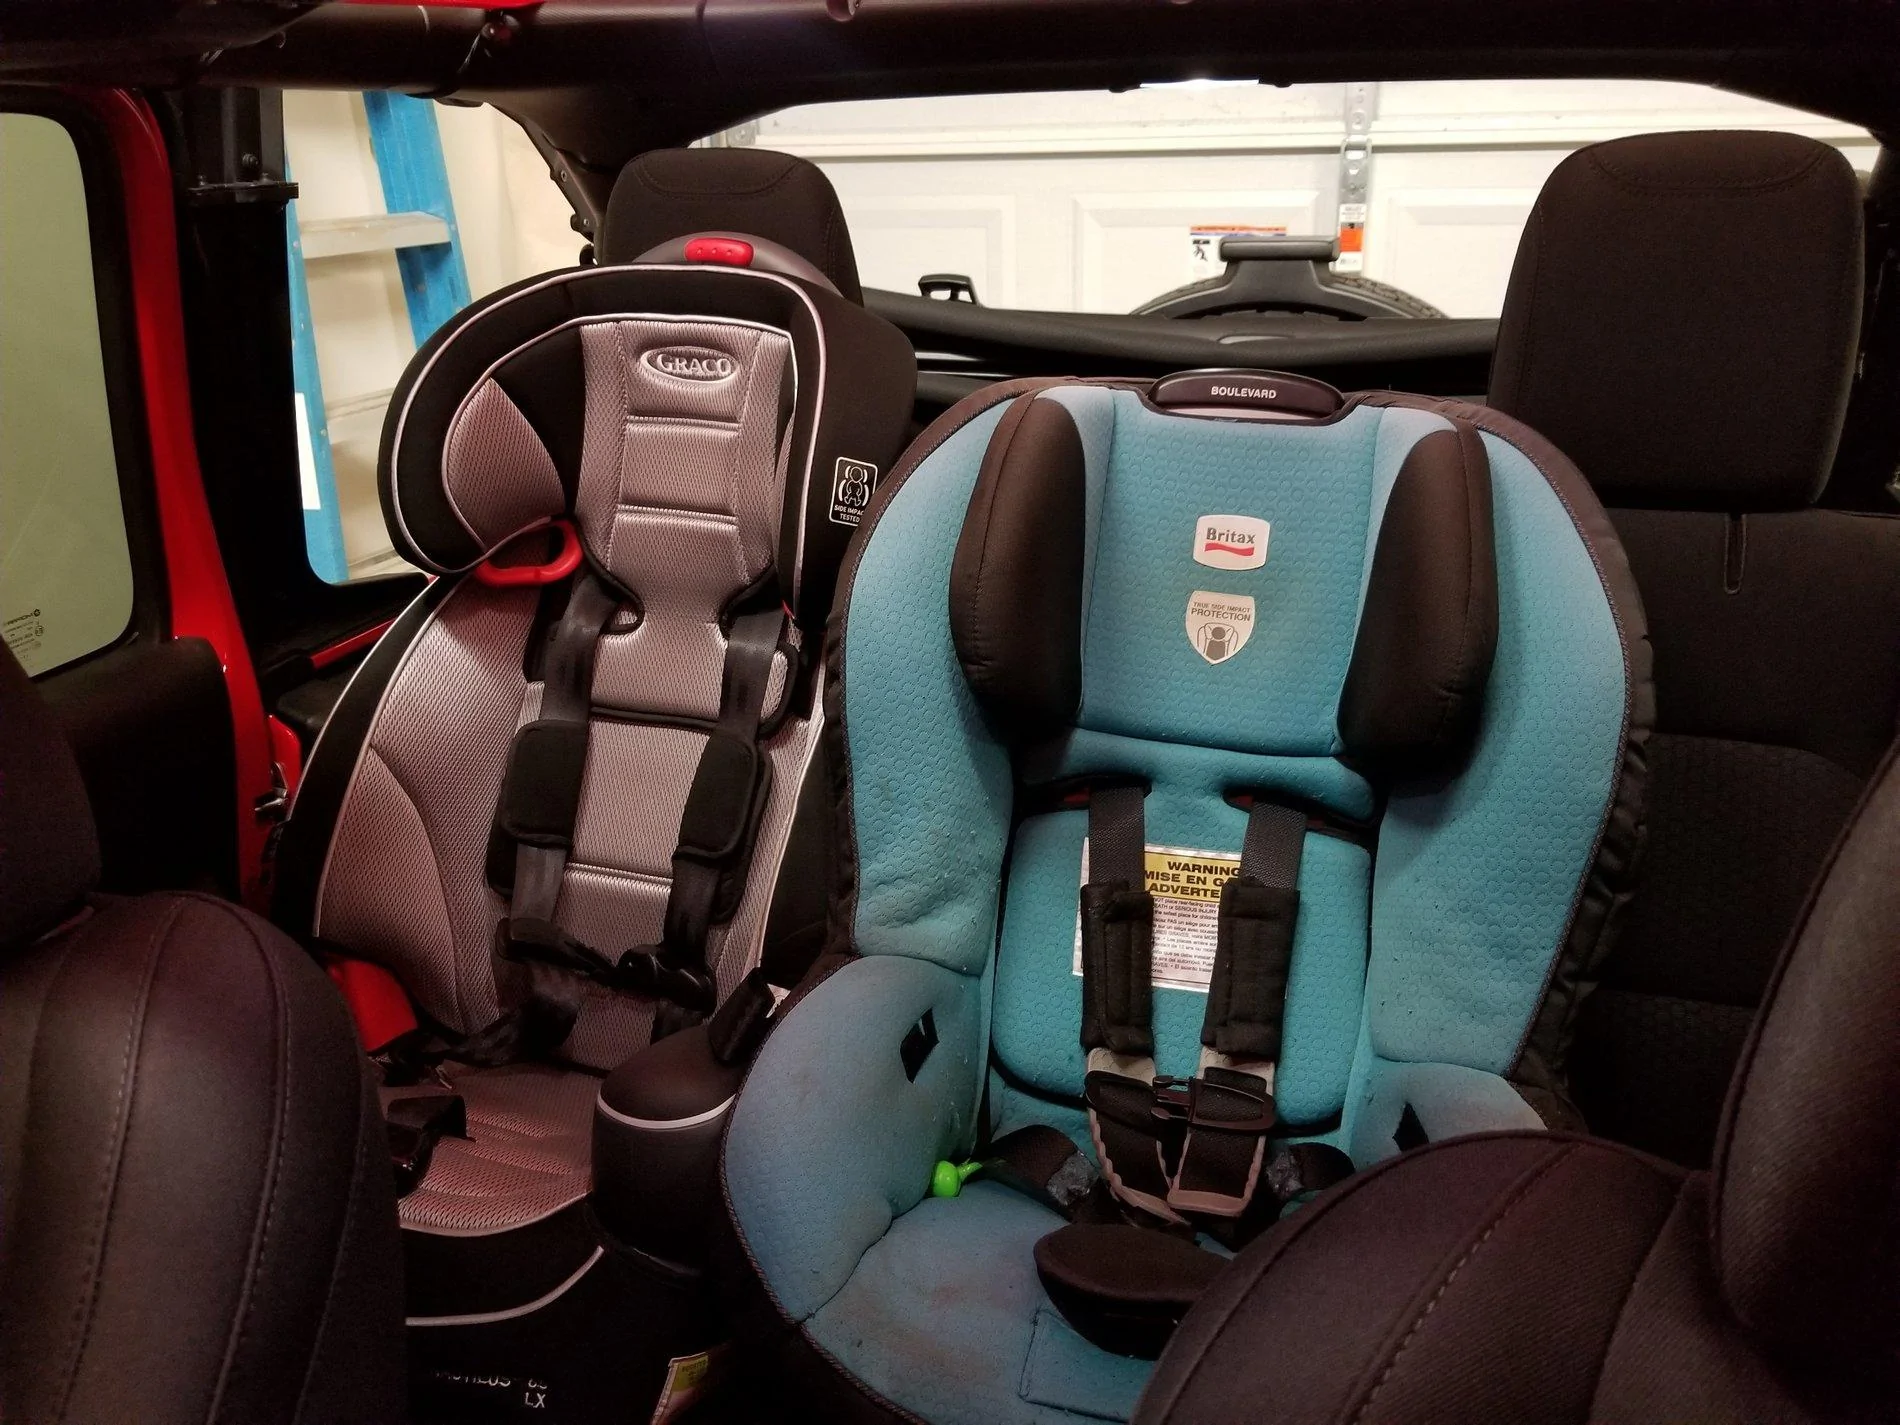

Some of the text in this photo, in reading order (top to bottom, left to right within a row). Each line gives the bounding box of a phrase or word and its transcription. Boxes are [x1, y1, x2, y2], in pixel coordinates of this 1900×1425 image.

[656, 353, 732, 375] GRACO
[1211, 386, 1277, 399] BOULEVARD
[840, 513, 860, 522] TESTED
[847, 507, 864, 516] IMPAC
[1206, 527, 1256, 544] Britax
[1191, 608, 1251, 622] PROTECTION
[1211, 603, 1225, 611] SIDE
[1227, 605, 1250, 613] IMPACT
[1167, 861, 1241, 877] WARNING
[1144, 870, 1181, 882] MISE
[1186, 875, 1207, 886] EN
[1148, 882, 1220, 899] ADVERTE
[524, 1392, 547, 1408] LX
